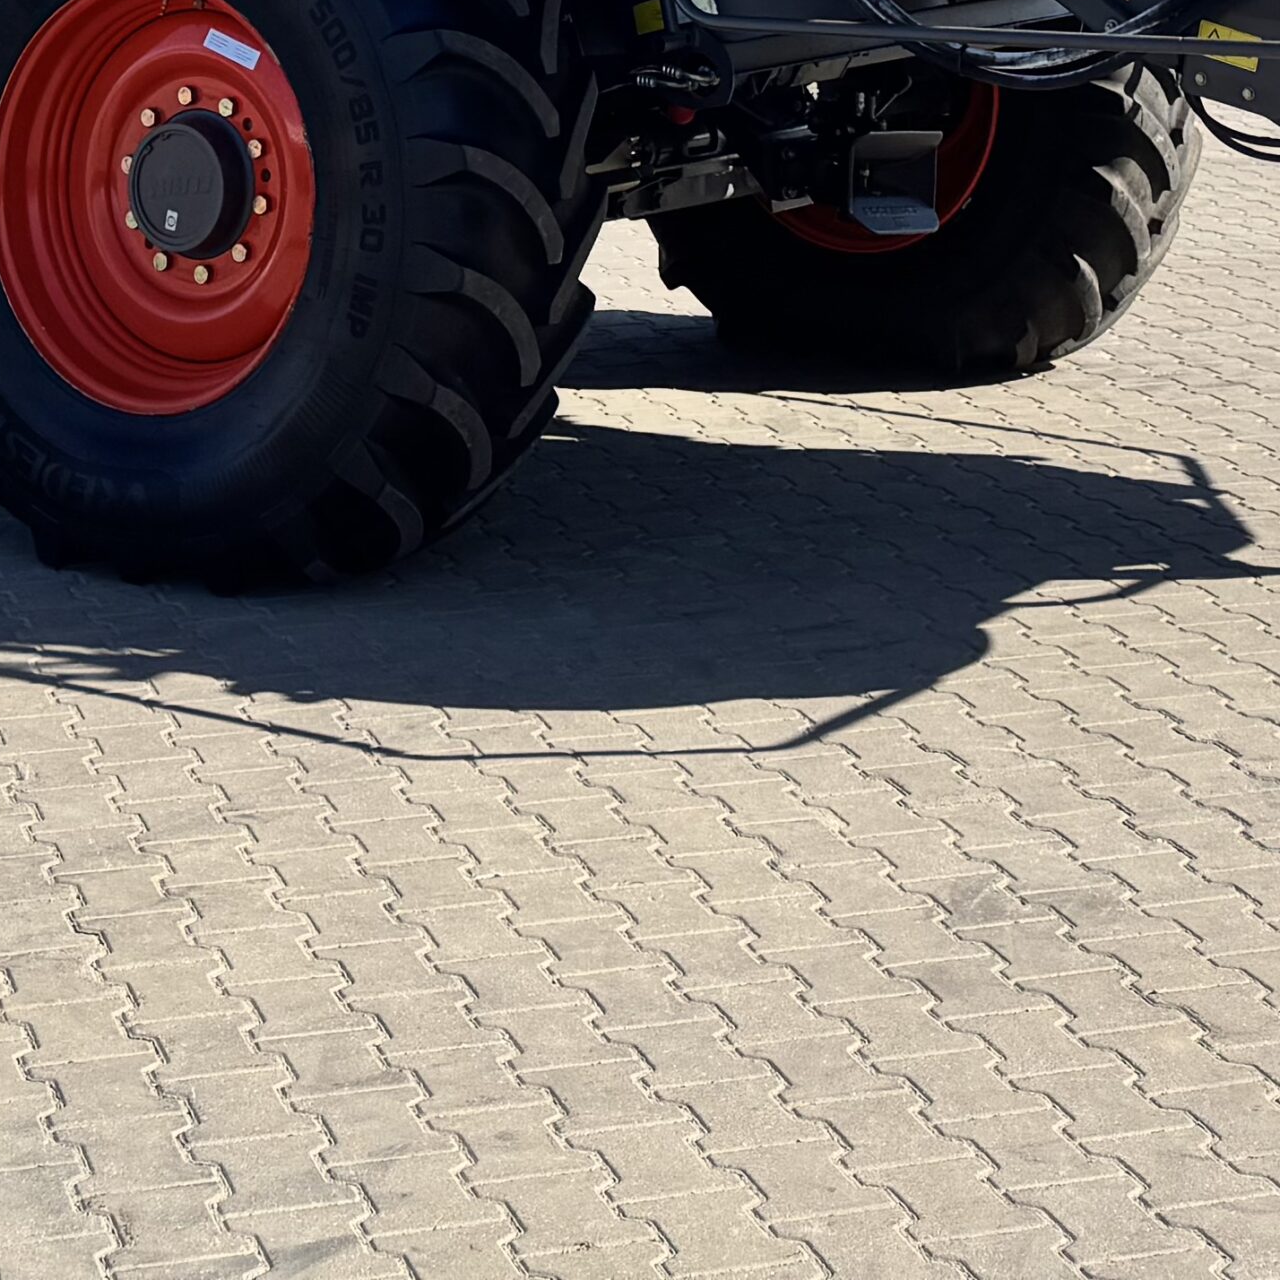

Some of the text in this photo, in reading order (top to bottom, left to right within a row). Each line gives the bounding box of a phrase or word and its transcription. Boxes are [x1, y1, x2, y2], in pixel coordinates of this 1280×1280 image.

[359, 159, 384, 190] R
[359, 203, 387, 254] 30
[346, 272, 379, 340] IMP
